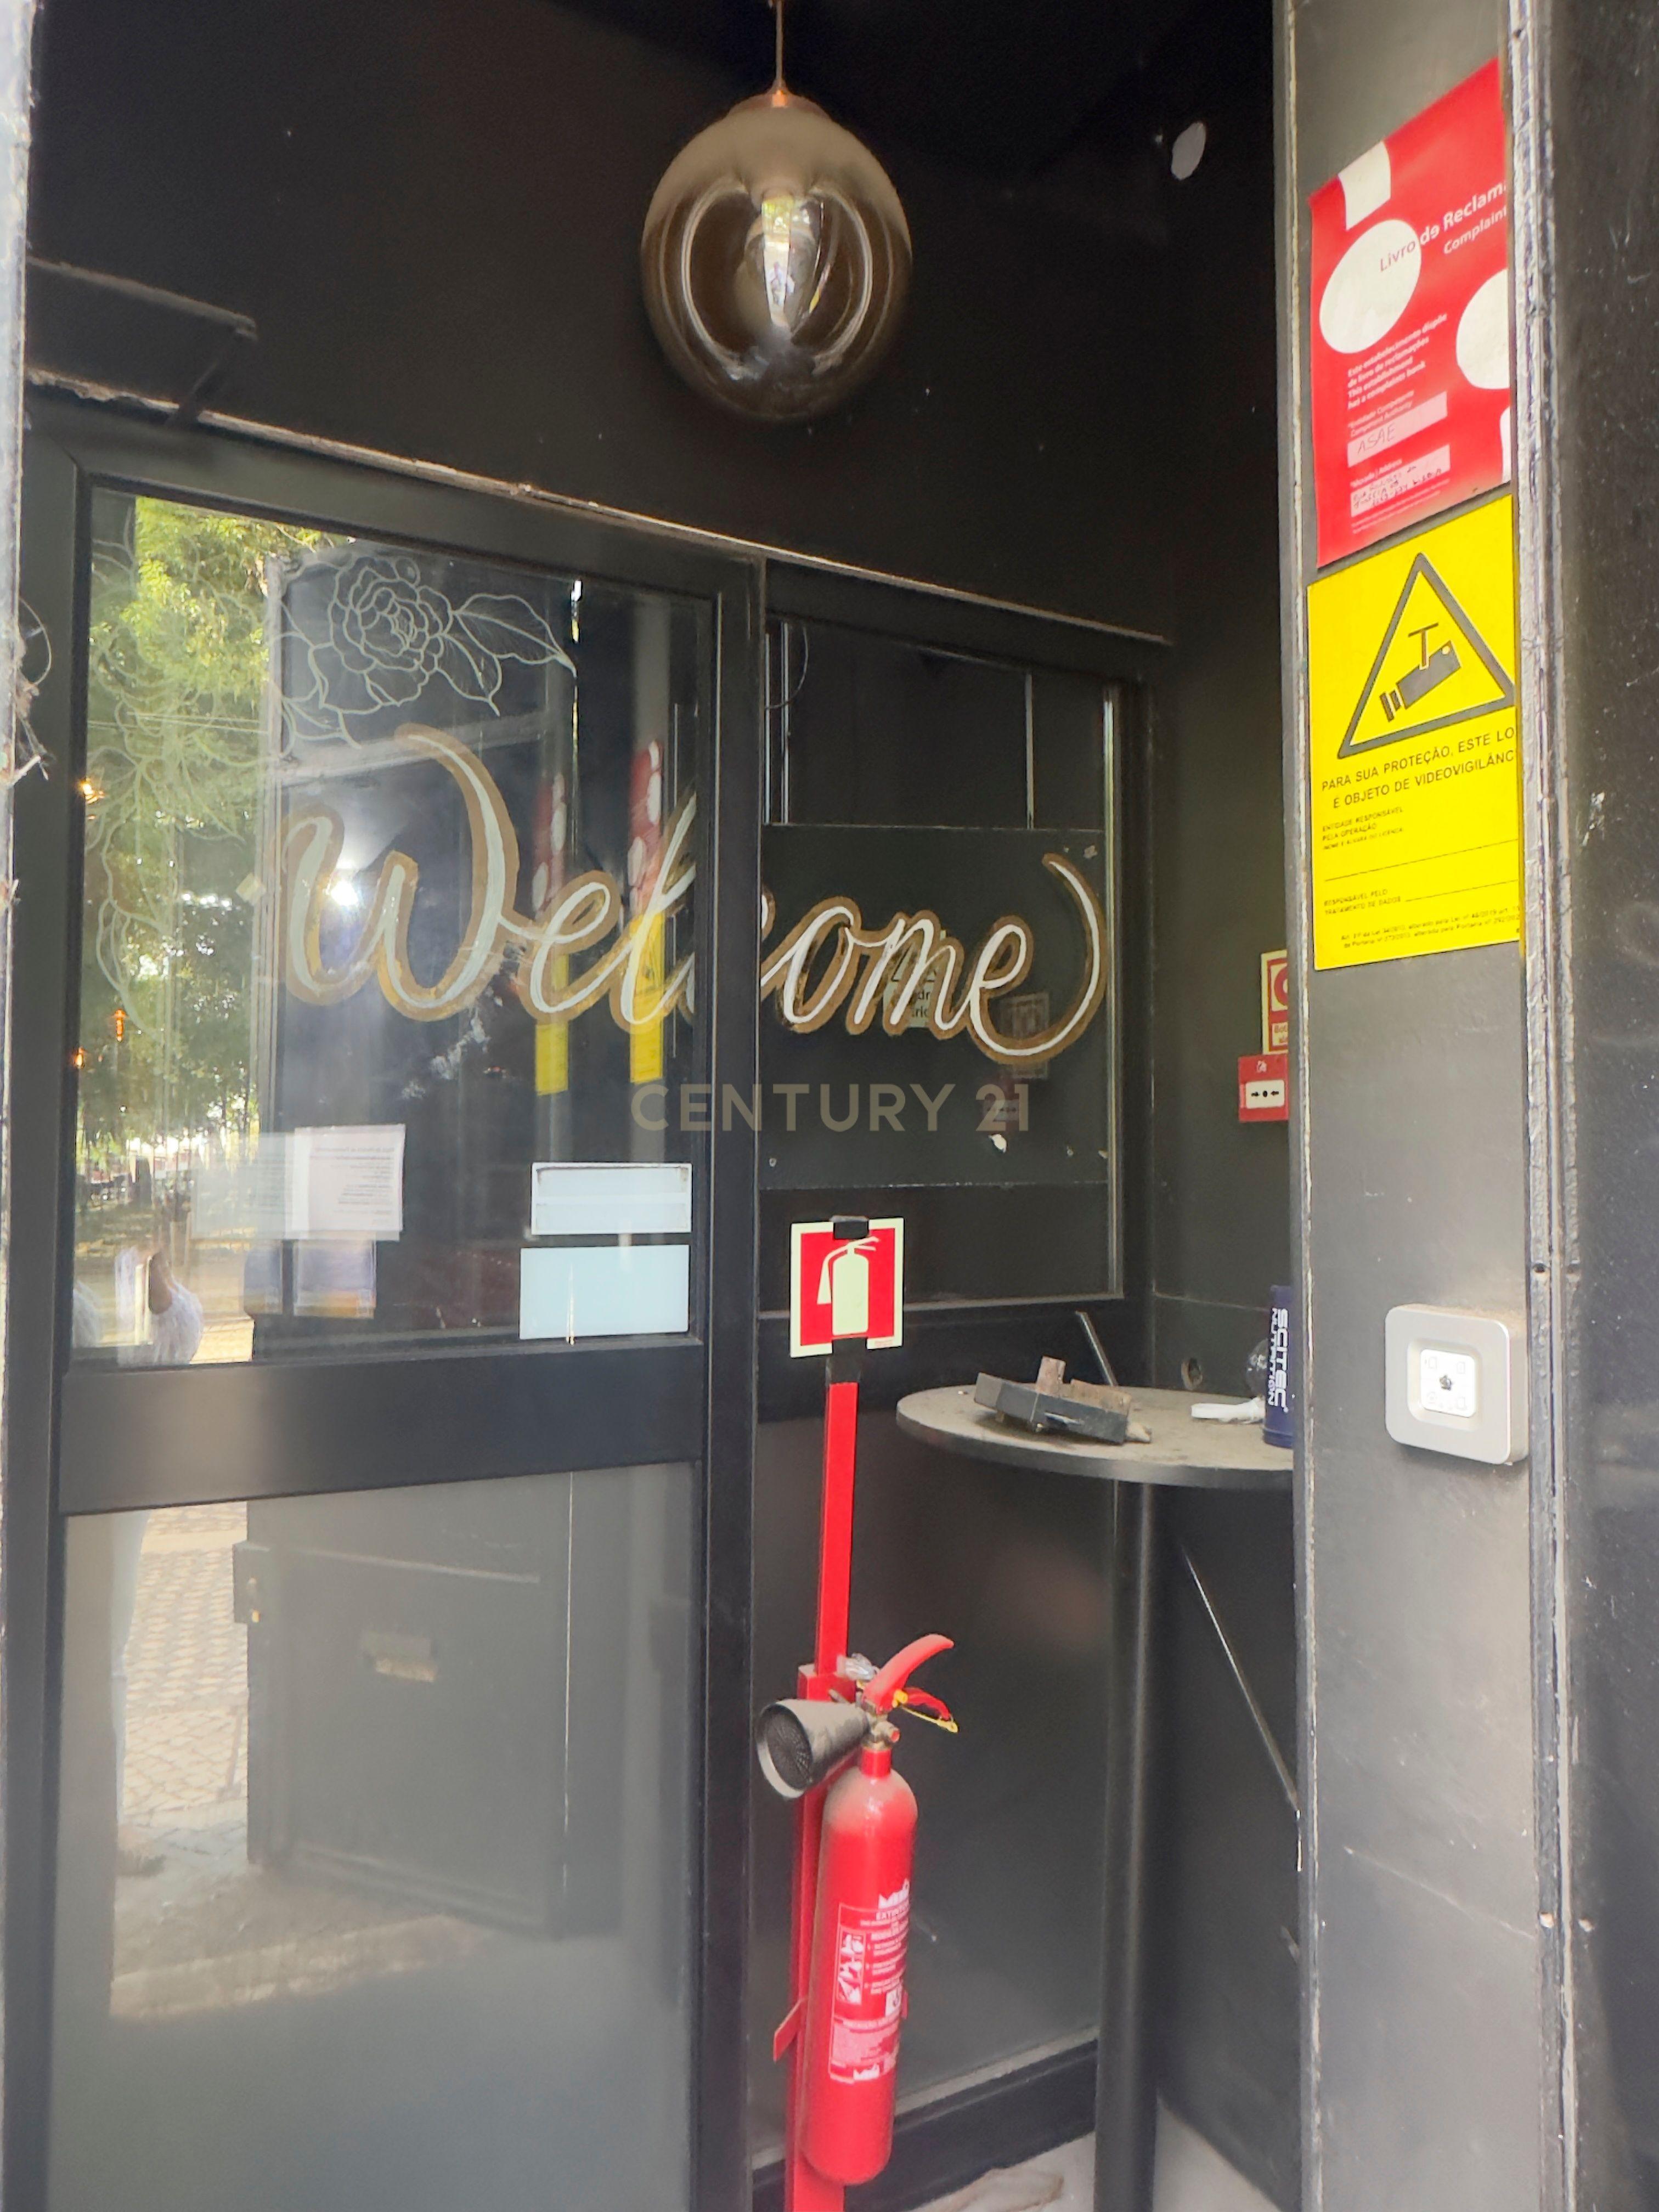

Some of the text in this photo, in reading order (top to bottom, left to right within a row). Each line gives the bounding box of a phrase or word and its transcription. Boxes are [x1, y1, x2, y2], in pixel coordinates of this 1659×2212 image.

[1380, 239, 1416, 272] Livro
[1322, 775, 1351, 791] PARA
[1356, 766, 1379, 782] SUA
[1458, 733, 1491, 753] ESTE
[1345, 785, 1390, 805] OBJETO
[1395, 778, 1410, 792] DE
[1275, 1308, 1288, 1407] SCITEC
